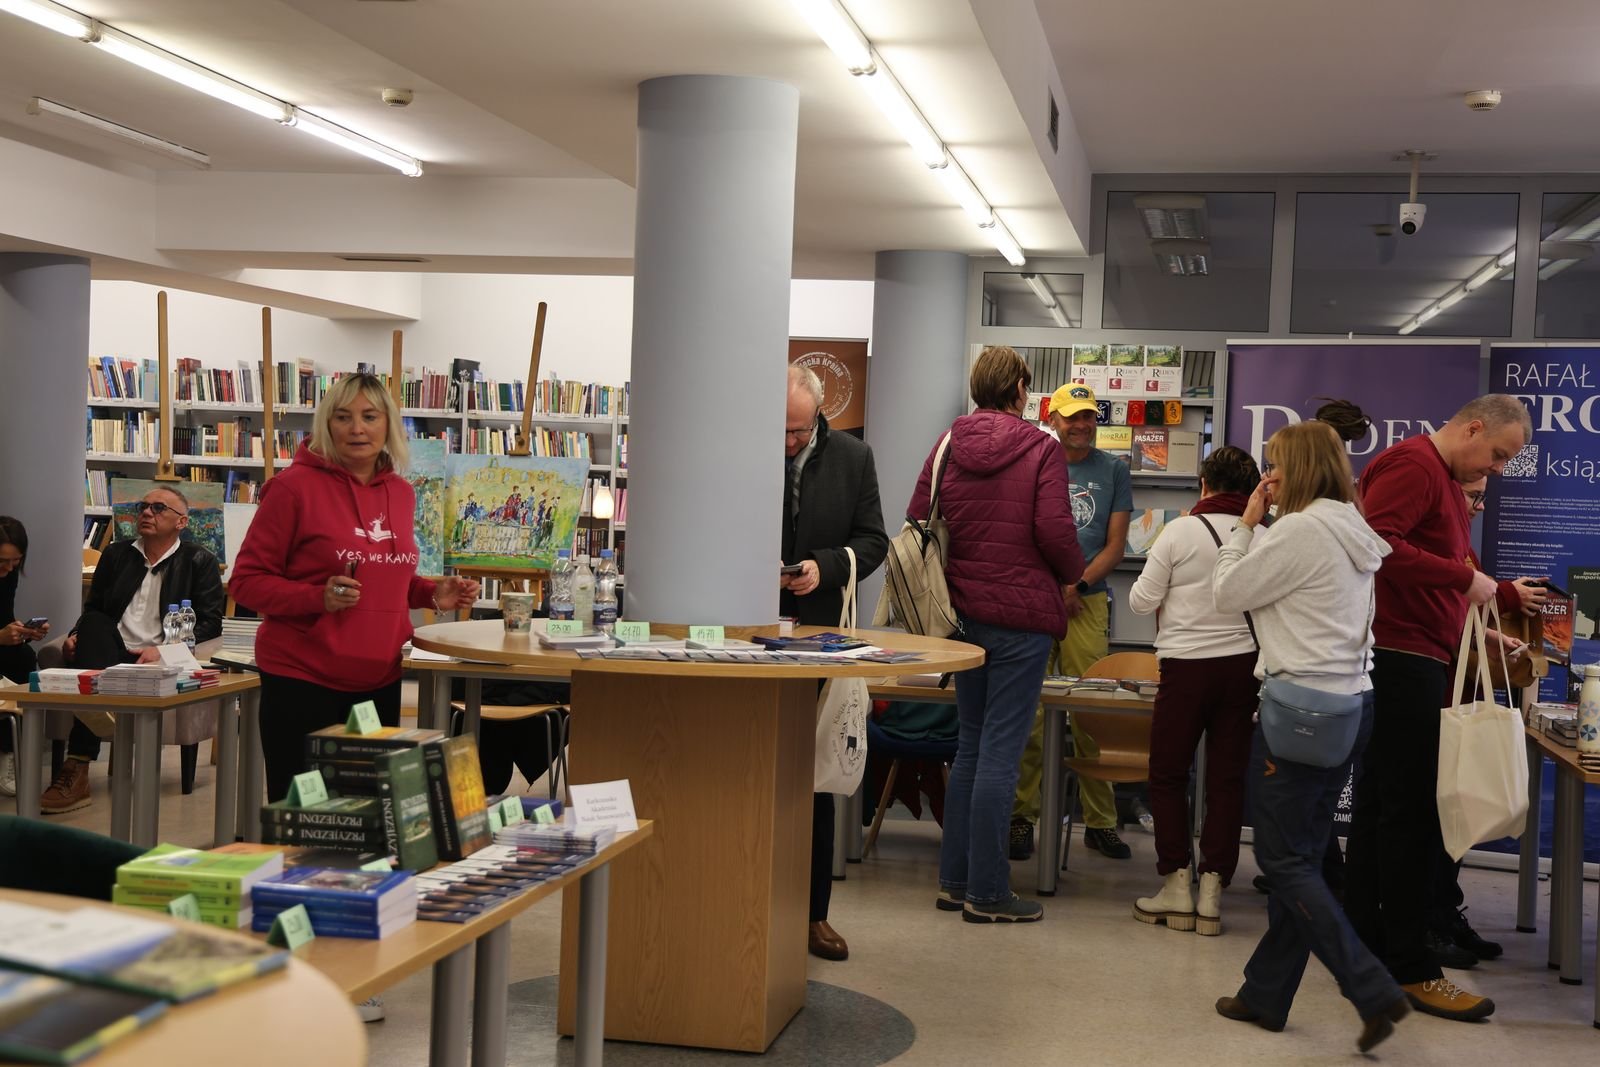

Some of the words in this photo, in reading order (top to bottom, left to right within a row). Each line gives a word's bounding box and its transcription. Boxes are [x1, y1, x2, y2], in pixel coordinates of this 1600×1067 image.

[1505, 363, 1596, 388] RAFAŁ
[1134, 433, 1165, 443] PASAŻER
[1546, 452, 1600, 483] ksią
[336, 549, 366, 564] Yes,
[369, 552, 383, 563] we
[385, 552, 417, 565] KANS
[1540, 602, 1568, 615] AŻER
[299, 813, 363, 827] PRZYJEZDNI
[301, 829, 365, 842] PRZYJEZDNI
